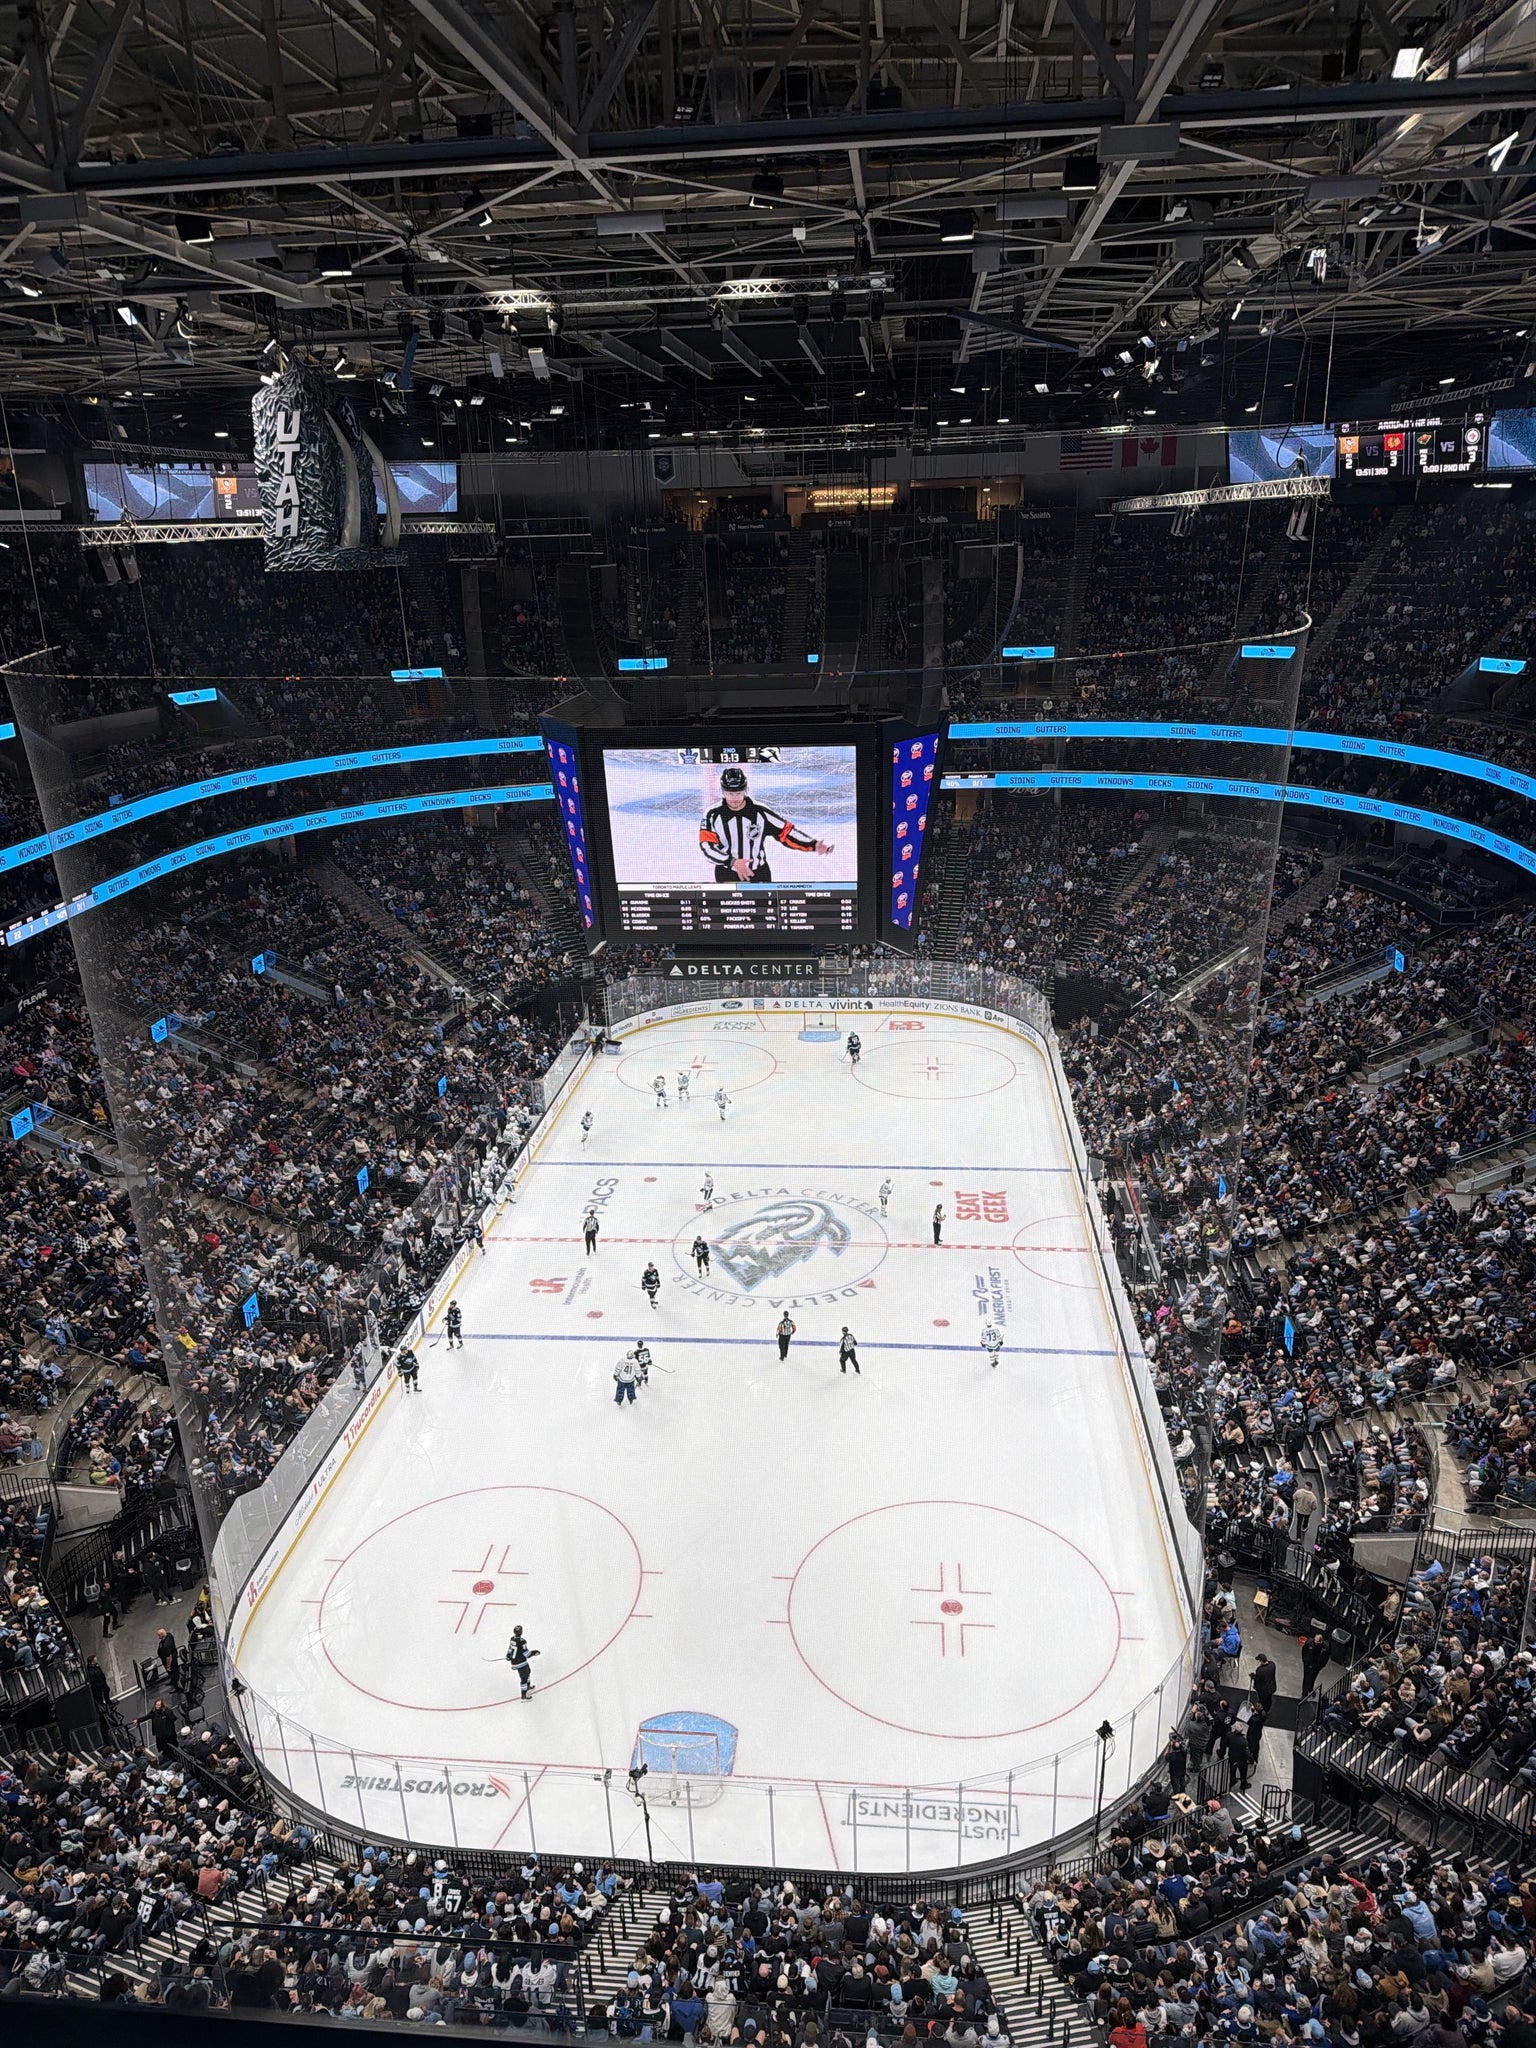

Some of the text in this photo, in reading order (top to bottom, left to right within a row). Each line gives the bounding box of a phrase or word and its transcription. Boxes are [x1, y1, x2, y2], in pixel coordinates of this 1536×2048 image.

[1366, 446, 1379, 456] VS
[1440, 441, 1455, 452] VS
[1346, 459, 1352, 469] 2
[1390, 456, 1398, 466] 3
[1420, 454, 1428, 465] 2
[1468, 452, 1476, 462] 3
[274, 411, 300, 537] UTAH
[225, 500, 232, 509] 2
[704, 749, 709, 758] 1
[720, 754, 740, 762] 13:13
[749, 748, 756, 757] 3
[995, 726, 1530, 791] SIDING GUTTERS SIDING GUTTERS SIDING GUTTERS SIDING GUTTERS
[18, 840, 48, 860] WINDOWS
[57, 830, 75, 844] DECKS
[84, 820, 104, 834] SIDING
[112, 809, 134, 824] GUTTERS
[200, 782, 222, 794] SIDING
[232, 774, 258, 786] GUTTERS
[335, 757, 358, 767] SIDING
[372, 752, 401, 762] GUTTERS
[498, 740, 524, 749] SIDING
[1010, 776, 1036, 784] SIDING
[1098, 777, 1134, 786] WINDOWS
[1148, 779, 1172, 787] DECKS
[1187, 781, 1214, 790] SIDING
[1228, 784, 1260, 794] GUTTERS
[1274, 788, 1310, 800] WINDOWS
[1323, 795, 1345, 806] DECKS
[1358, 801, 1382, 813] SIDING
[1394, 808, 1421, 822] GUTTERS
[1432, 818, 1460, 834] WINDOWS
[1470, 829, 1486, 843] DECKS
[1494, 839, 1511, 854] SIDING
[1518, 850, 1536, 868] GUTTERS
[14, 930, 22, 940] 22
[108, 877, 130, 894] GUTTERS
[138, 863, 162, 880] WINDOWS
[170, 854, 187, 866] DECKS
[196, 844, 216, 857] SIDING
[226, 833, 251, 846] GUTTERS
[262, 823, 294, 837] WINDOWS
[306, 816, 328, 826] DECKS
[341, 810, 364, 820] SIDING
[378, 803, 408, 814] GUTTERS
[421, 798, 456, 808] WINDOWS
[470, 794, 492, 802] DECKS
[506, 790, 530, 799] SIDING
[688, 964, 813, 975] DELTA CENTER
[673, 1006, 708, 1014] INGREDIENTS
[829, 1000, 863, 1010] vivint
[879, 1000, 930, 1010] HealthEquity
[934, 1003, 981, 1017] ZIONS BANK
[582, 1178, 619, 1214] PACS
[714, 1188, 879, 1214] DELTA CENTER
[954, 1190, 982, 1221] SEAT
[982, 1190, 1009, 1223] GEEK
[989, 1266, 1002, 1290] FIRST
[672, 1274, 858, 1308] DELTA CENTER
[410, 1296, 420, 1306] 92
[990, 1290, 1007, 1326] AMERICA
[987, 1332, 996, 1341] 73
[638, 1354, 650, 1364] 56
[624, 1366, 632, 1375] 41
[350, 1387, 382, 1438] Trucordia
[318, 1458, 336, 1486] ULTRA
[340, 1775, 500, 1798] CROWDSTRIKE
[858, 1801, 1007, 1824] INGREDIENTS
[962, 1825, 1008, 1840] JUST
[445, 1895, 461, 1913] 67
